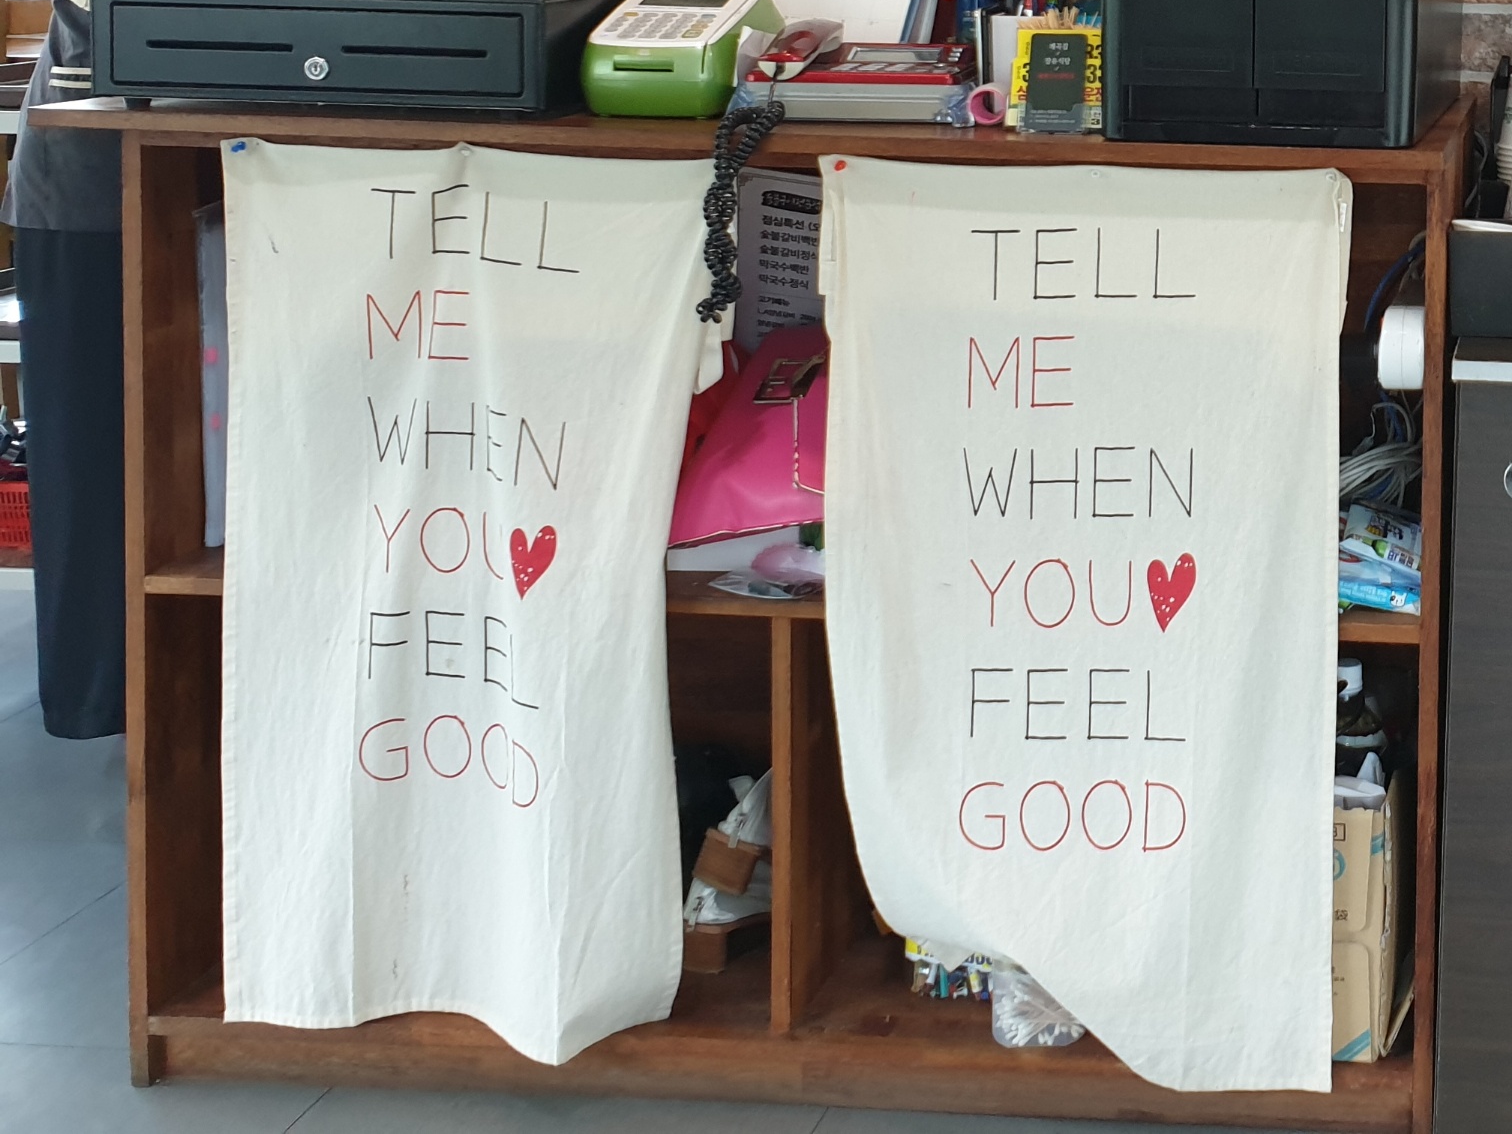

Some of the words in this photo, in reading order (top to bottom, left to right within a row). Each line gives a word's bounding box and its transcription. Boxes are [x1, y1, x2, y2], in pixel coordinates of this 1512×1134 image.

[371, 184, 580, 273] TELL
[970, 228, 1197, 301] TELL
[758, 274, 809, 290] 막국수정식
[366, 289, 470, 360] ME
[968, 335, 1076, 408] ME
[367, 396, 566, 490] WHEN
[963, 446, 1194, 520] WHEN
[970, 558, 1133, 628] YOU
[367, 611, 539, 710] FEEL
[970, 669, 1186, 741] FEEL
[359, 715, 539, 808] GOOD
[958, 780, 1187, 854] GOOD
